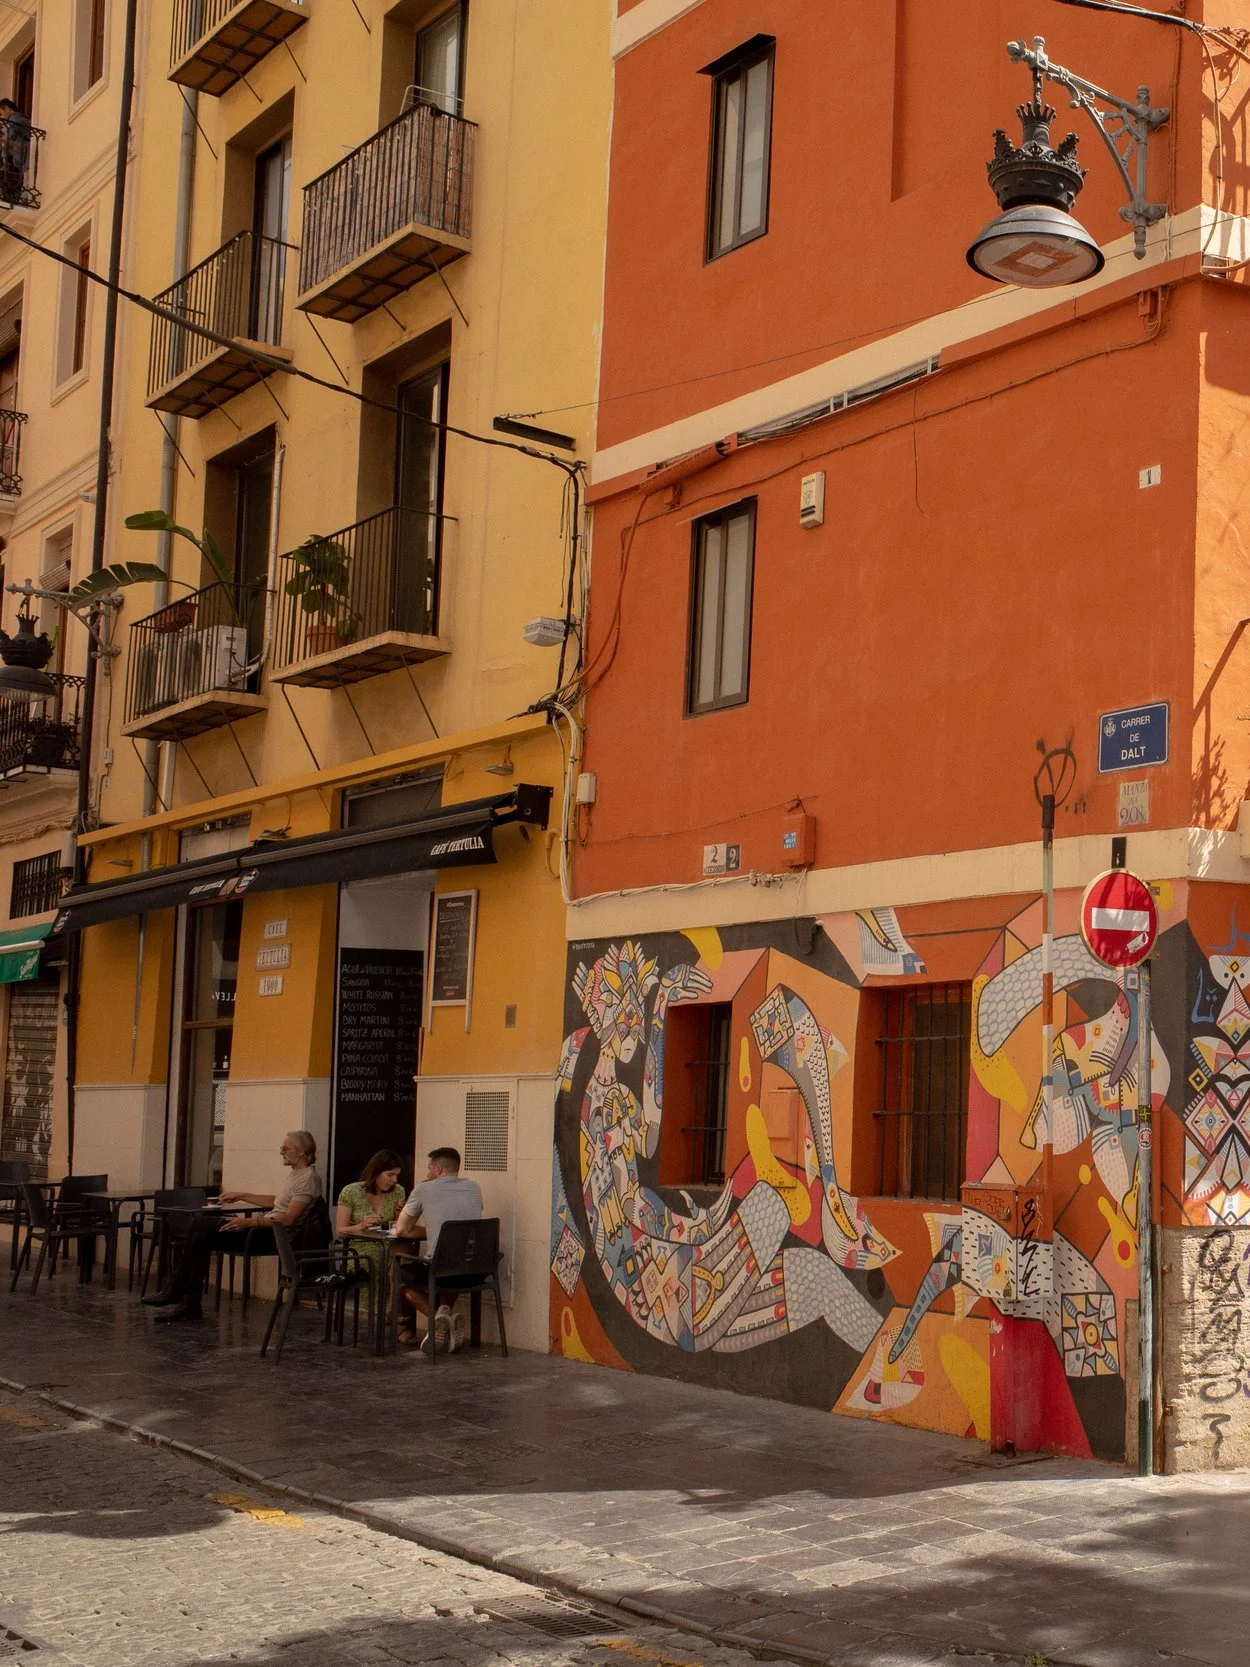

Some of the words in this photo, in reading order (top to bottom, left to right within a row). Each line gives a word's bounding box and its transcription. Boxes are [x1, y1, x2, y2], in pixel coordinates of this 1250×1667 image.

[1120, 715, 1151, 729] CARRER
[1129, 732, 1140, 743] DE
[1121, 746, 1146, 760] DALT
[430, 840, 450, 856] CAFÉ
[447, 836, 485, 852] TERTULIA
[711, 845, 718, 864] 2
[730, 848, 737, 869] 2
[342, 989, 364, 1000] WHITE
[366, 989, 394, 1000] RUSSIAN
[342, 1015, 357, 1025] DRY
[360, 1015, 390, 1025] MARTINI
[342, 1028, 368, 1038] SPRITZ
[342, 1041, 384, 1051] MARGARITA
[341, 1092, 385, 1102] MANHATTAN
